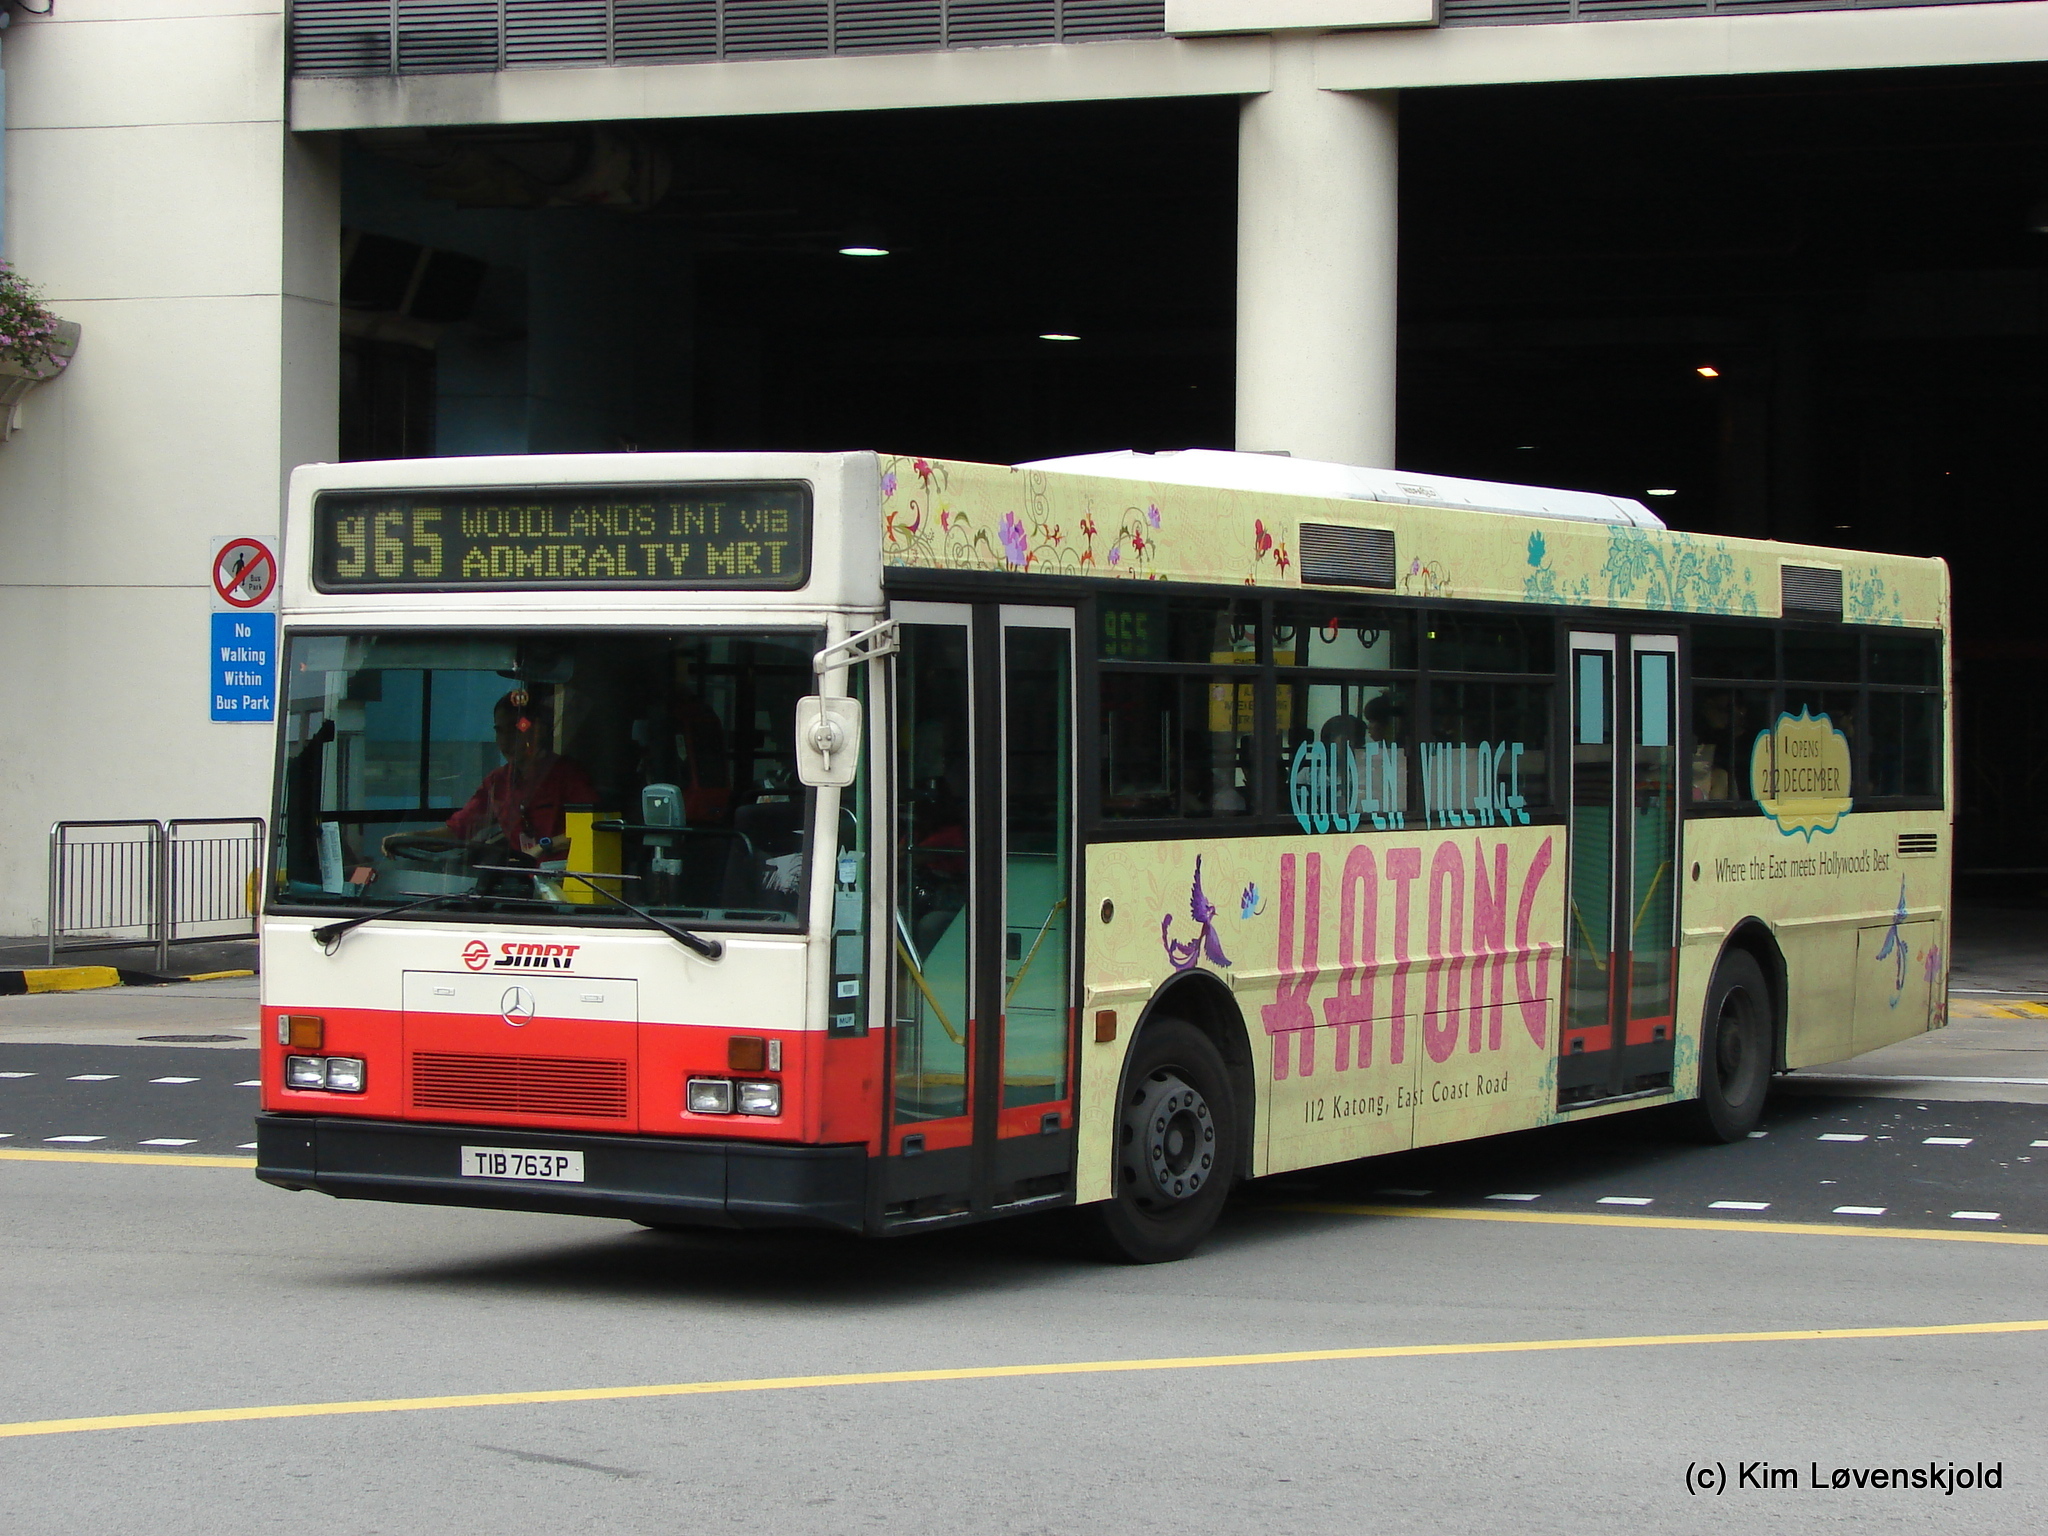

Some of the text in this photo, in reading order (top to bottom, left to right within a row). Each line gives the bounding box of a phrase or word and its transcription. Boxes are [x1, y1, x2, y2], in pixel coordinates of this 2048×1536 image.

[461, 505, 657, 538] WOODLANDS
[669, 502, 726, 535] INT
[336, 506, 443, 578] 965
[462, 541, 788, 578] ADMIRALTY MRT
[248, 583, 262, 591] Park
[250, 574, 262, 582] Bus
[235, 623, 251, 638] No
[220, 647, 266, 666] Walking
[224, 671, 262, 686] Within
[216, 695, 270, 710] Bus Park
[1791, 740, 1819, 758] OPENS
[1289, 739, 1531, 834] GOLDEN VILLAGE
[1784, 767, 1840, 793] DECEMBER
[1715, 849, 1890, 883] Where the East meets Hollywood's Best
[494, 943, 581, 969] SMRT
[1261, 835, 1553, 1082] KATONG
[1305, 1071, 1508, 1123] 112 Katong, East Coast Road
